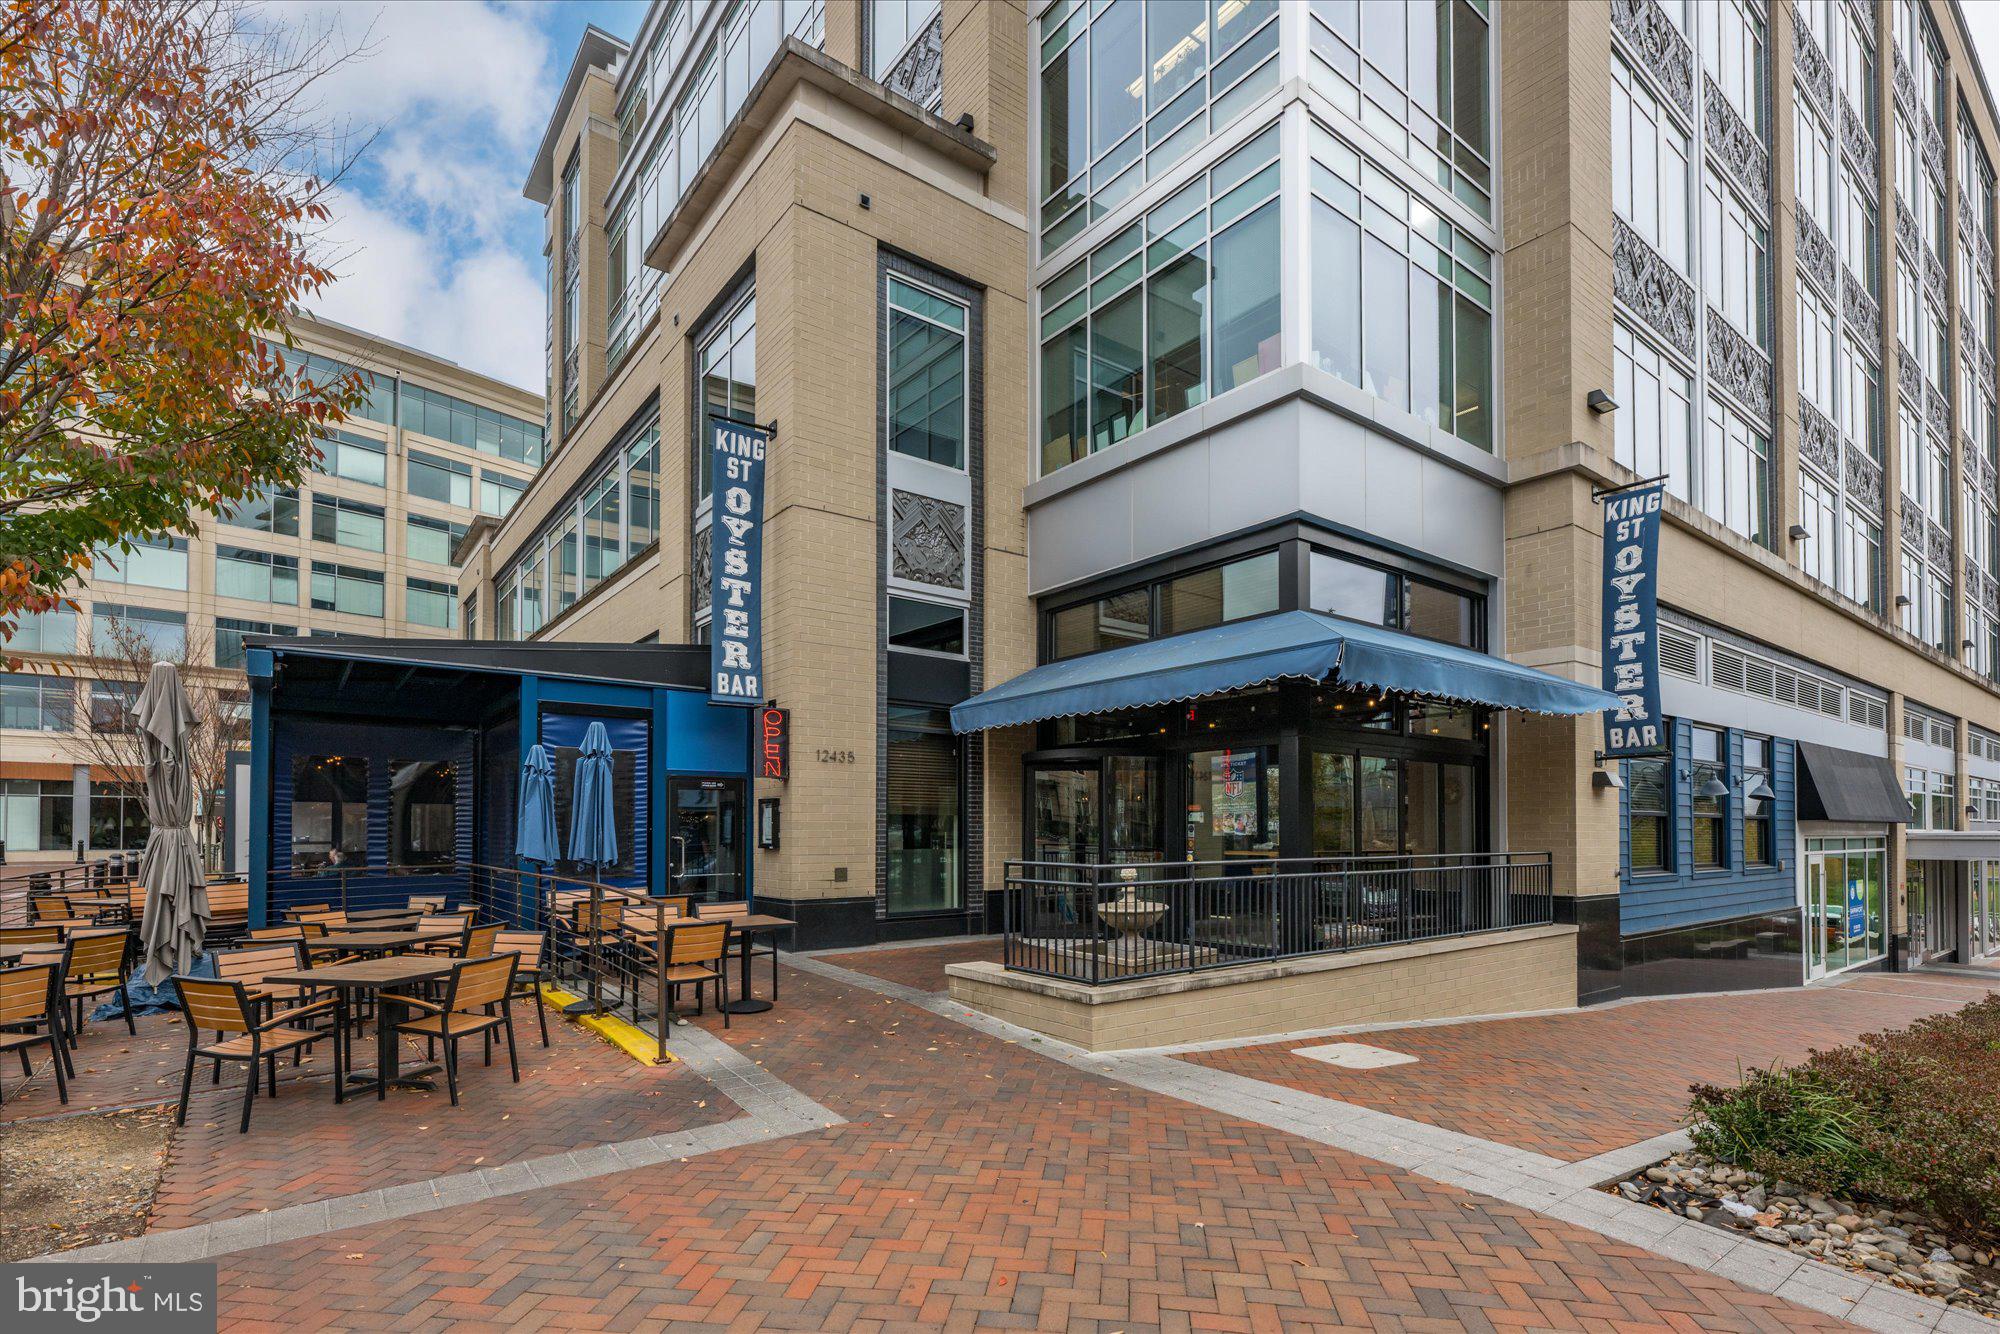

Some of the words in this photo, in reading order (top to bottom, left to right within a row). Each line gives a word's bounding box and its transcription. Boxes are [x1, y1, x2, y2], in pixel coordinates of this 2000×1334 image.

[715, 428, 765, 461] KING
[726, 456, 753, 482] ST
[1605, 492, 1661, 523] KING
[1616, 517, 1645, 543] ST
[721, 486, 754, 670] OYSTER
[1610, 544, 1649, 722] OYSTER
[717, 672, 758, 697] BAR
[763, 709, 783, 777] OPEN
[1609, 725, 1658, 749] BAR
